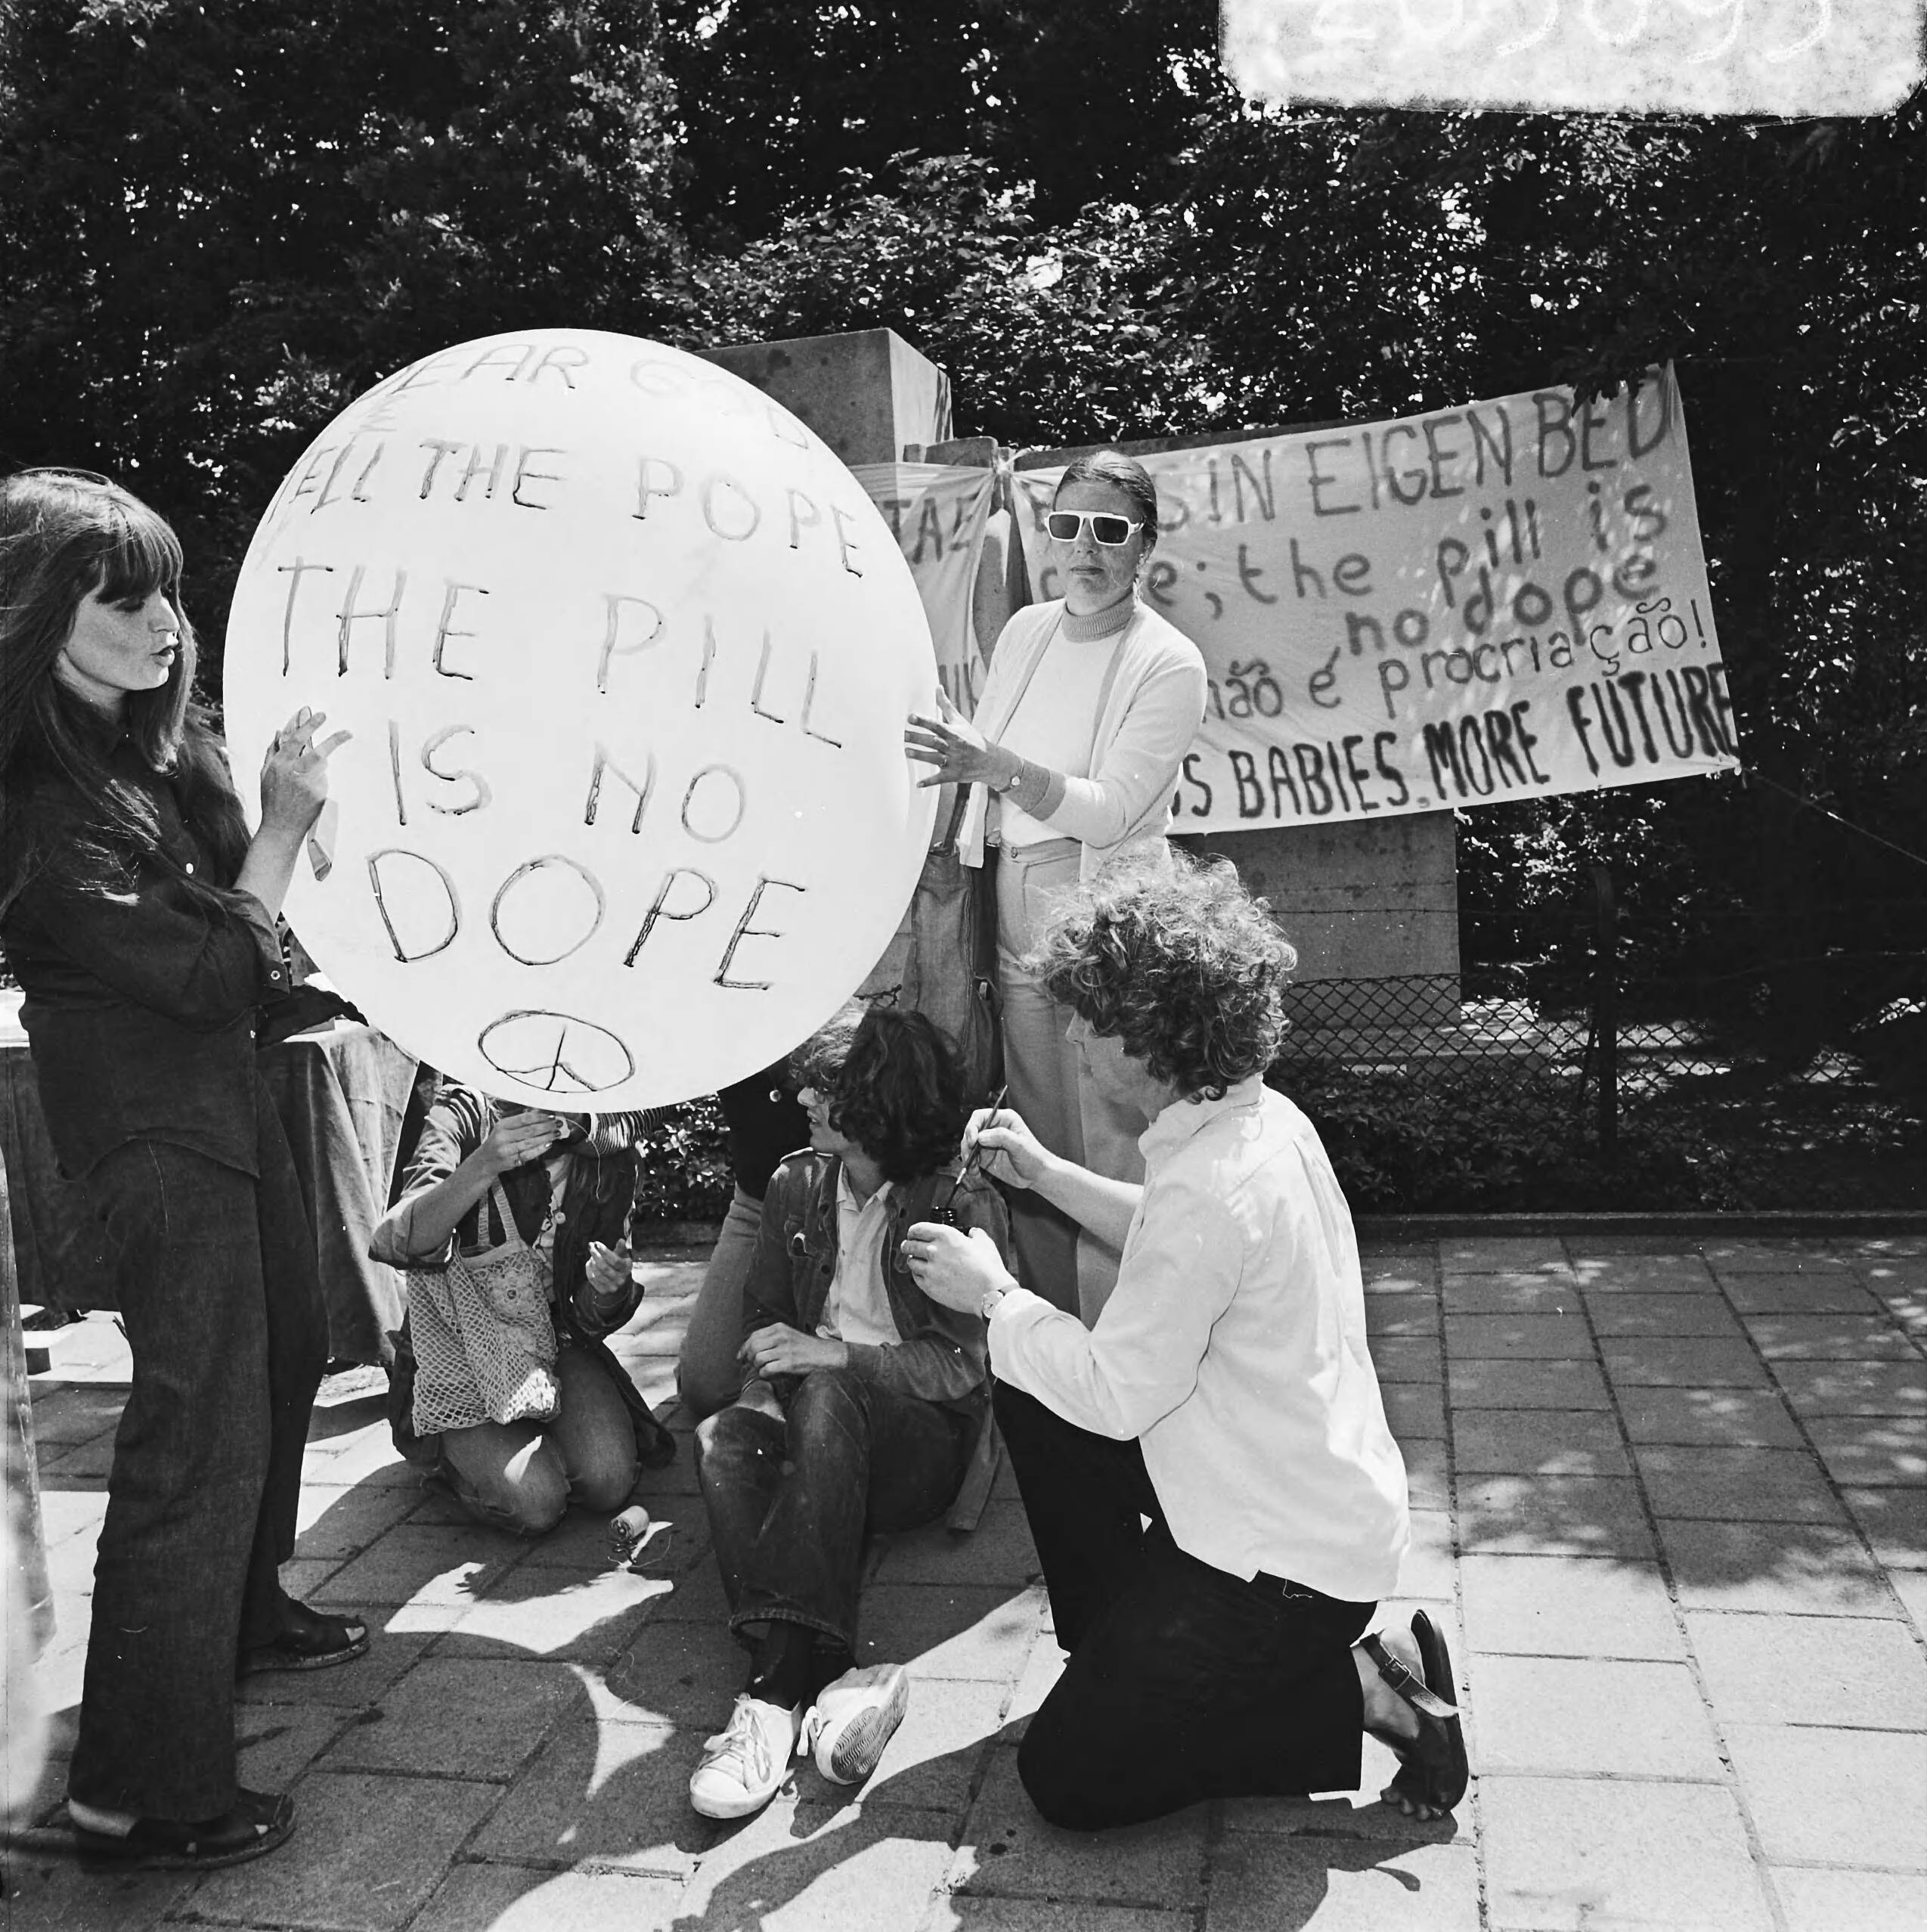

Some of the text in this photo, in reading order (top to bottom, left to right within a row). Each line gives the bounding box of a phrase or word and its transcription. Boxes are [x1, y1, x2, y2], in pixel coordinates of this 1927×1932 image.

[418, 437, 567, 511] THE
[632, 456, 863, 578] POPE
[1306, 406, 1513, 518] EIGEN
[1532, 367, 1669, 478] BED
[1238, 538, 1372, 604] the
[1436, 498, 1541, 609] pill
[1588, 480, 1667, 553] is
[1345, 552, 1659, 656] no dope
[277, 555, 491, 681] THE
[596, 594, 841, 749] PILL
[387, 718, 747, 843] IS NO
[1422, 699, 1551, 802] MORE
[1566, 661, 1739, 778] FUTURE
[367, 848, 807, 991] DOPE
